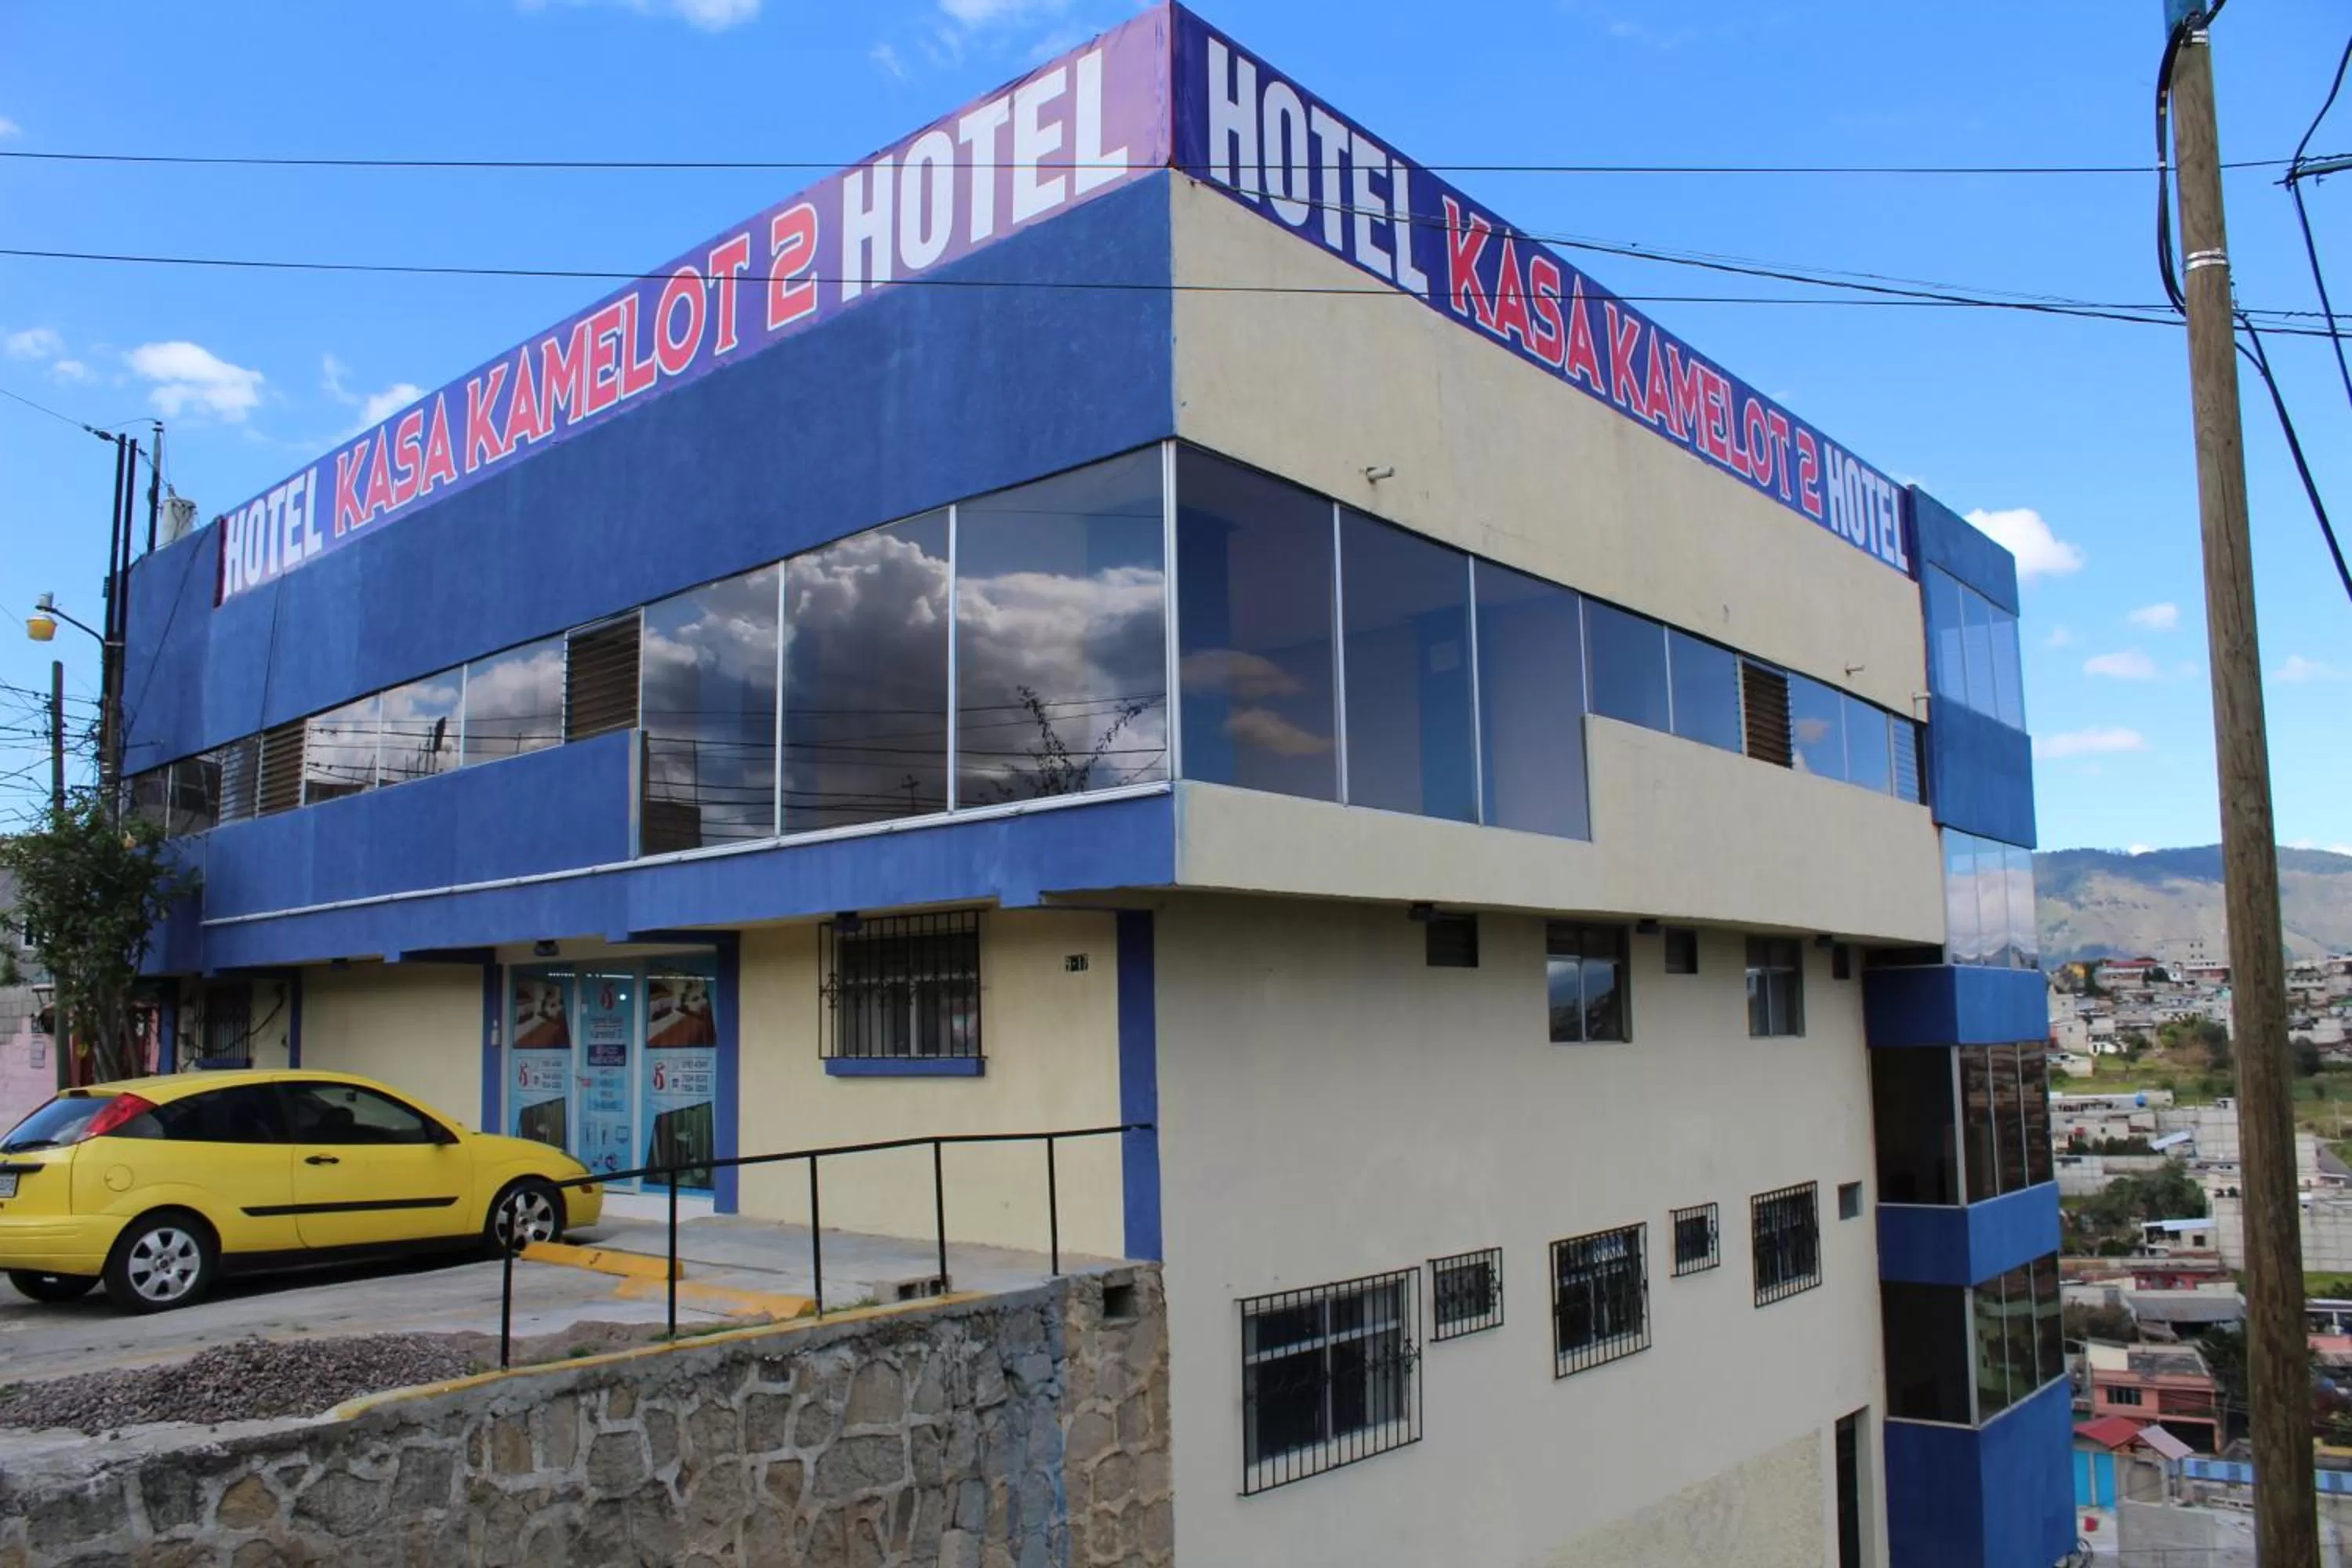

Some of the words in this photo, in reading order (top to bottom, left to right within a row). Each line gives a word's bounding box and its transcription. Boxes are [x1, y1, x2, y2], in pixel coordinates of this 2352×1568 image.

[841, 48, 1128, 303] HOTEL
[1208, 36, 1429, 299] HOTEL
[1443, 194, 1606, 396] KASA
[1605, 300, 1792, 503] KAMELOT
[1797, 426, 1822, 520] 2
[1824, 441, 1908, 572] HOTEL
[222, 467, 322, 598] HOTEL
[334, 394, 456, 538] KASA
[466, 233, 750, 474] KAMELOT
[768, 201, 818, 332] 2
